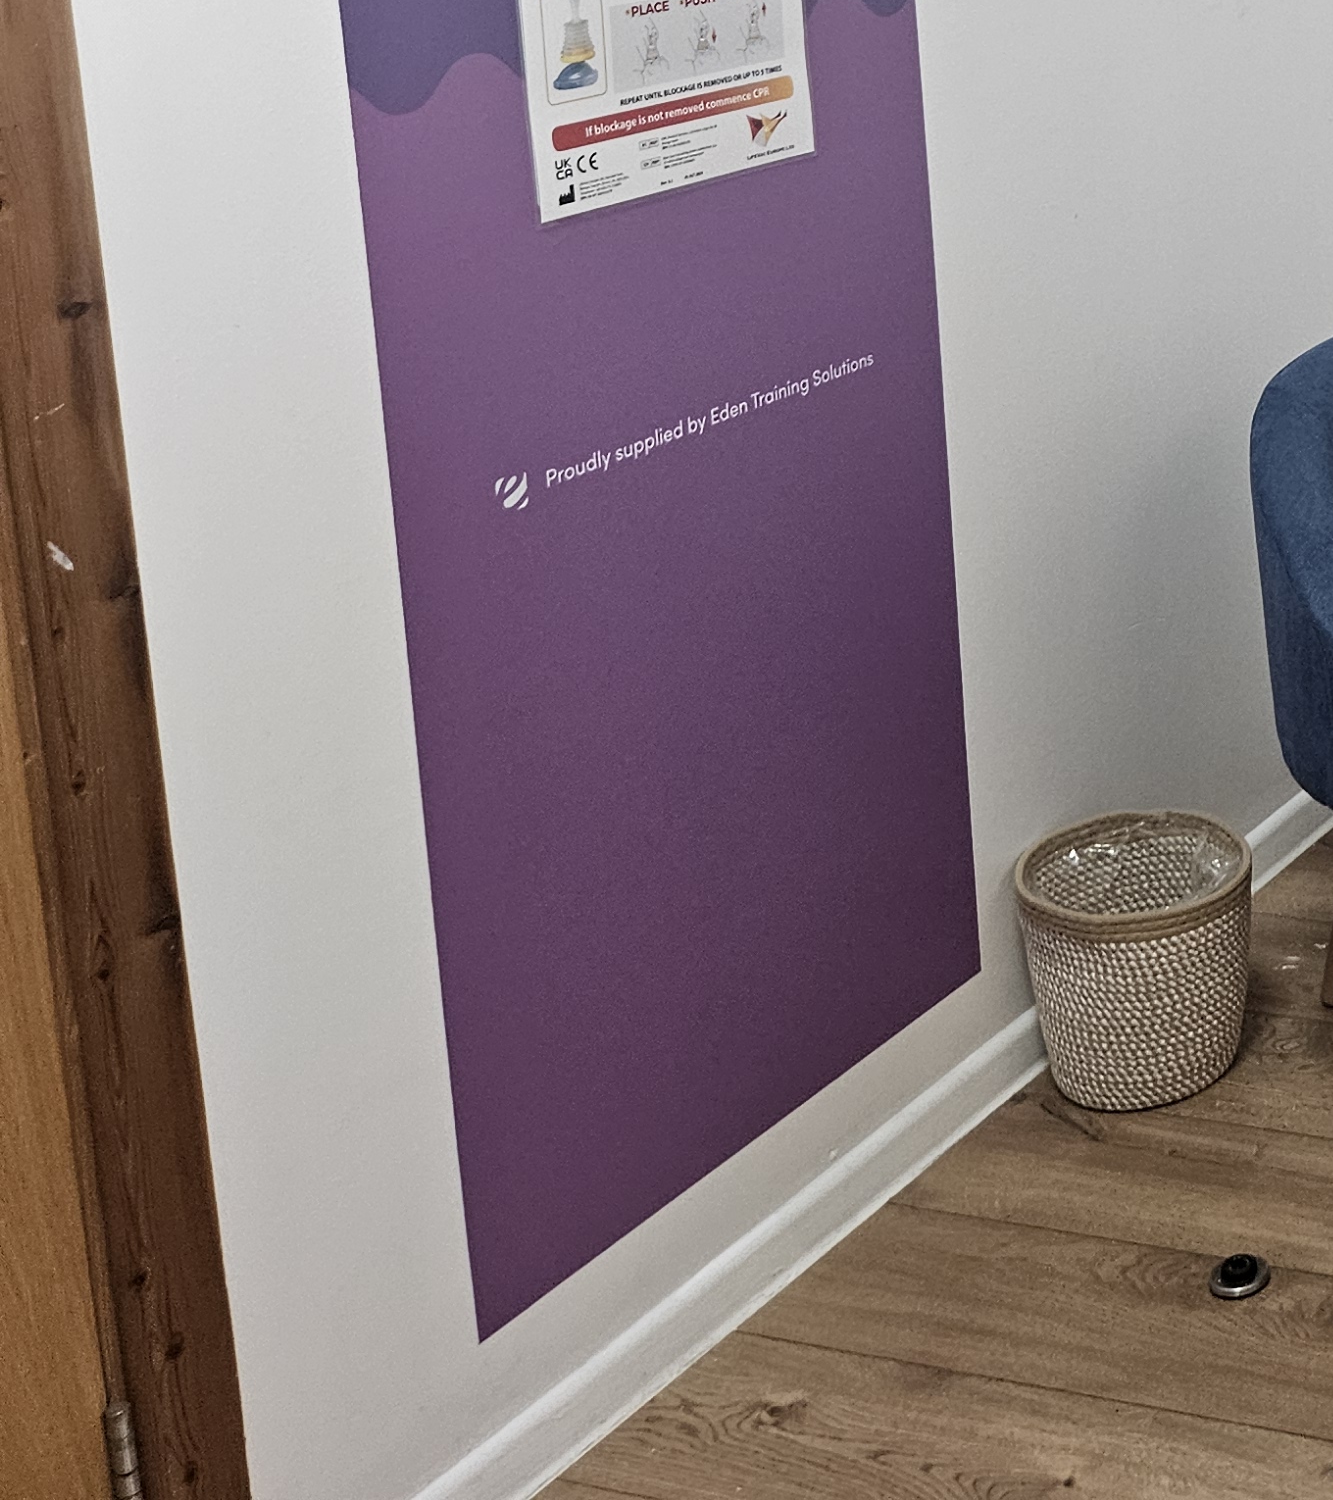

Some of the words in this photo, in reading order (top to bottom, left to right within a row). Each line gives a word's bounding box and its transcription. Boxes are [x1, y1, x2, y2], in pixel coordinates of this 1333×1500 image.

[631, 0, 670, 17] PLACE
[620, 95, 644, 106] REPEAT
[645, 91, 662, 101] UNTIL
[663, 83, 697, 97] BLOCKAGE
[697, 82, 703, 90] IS
[703, 75, 732, 88] REMOVED
[733, 73, 742, 82] OR
[742, 71, 751, 80] UP
[751, 69, 760, 77] TO
[765, 65, 782, 74] TIMES
[585, 126, 594, 137] If
[594, 114, 637, 135] blockage
[638, 113, 647, 125] is
[648, 111, 664, 123] not
[665, 101, 704, 119] removed
[705, 92, 751, 109] commence
[753, 87, 770, 99] CPR
[555, 157, 572, 170] UK
[556, 169, 574, 181] CA
[545, 449, 612, 489] Proudly
[615, 420, 684, 469] supplied
[687, 414, 707, 435] by
[709, 401, 749, 426] Eden
[750, 377, 810, 409] Training
[812, 352, 875, 387] Solutions
